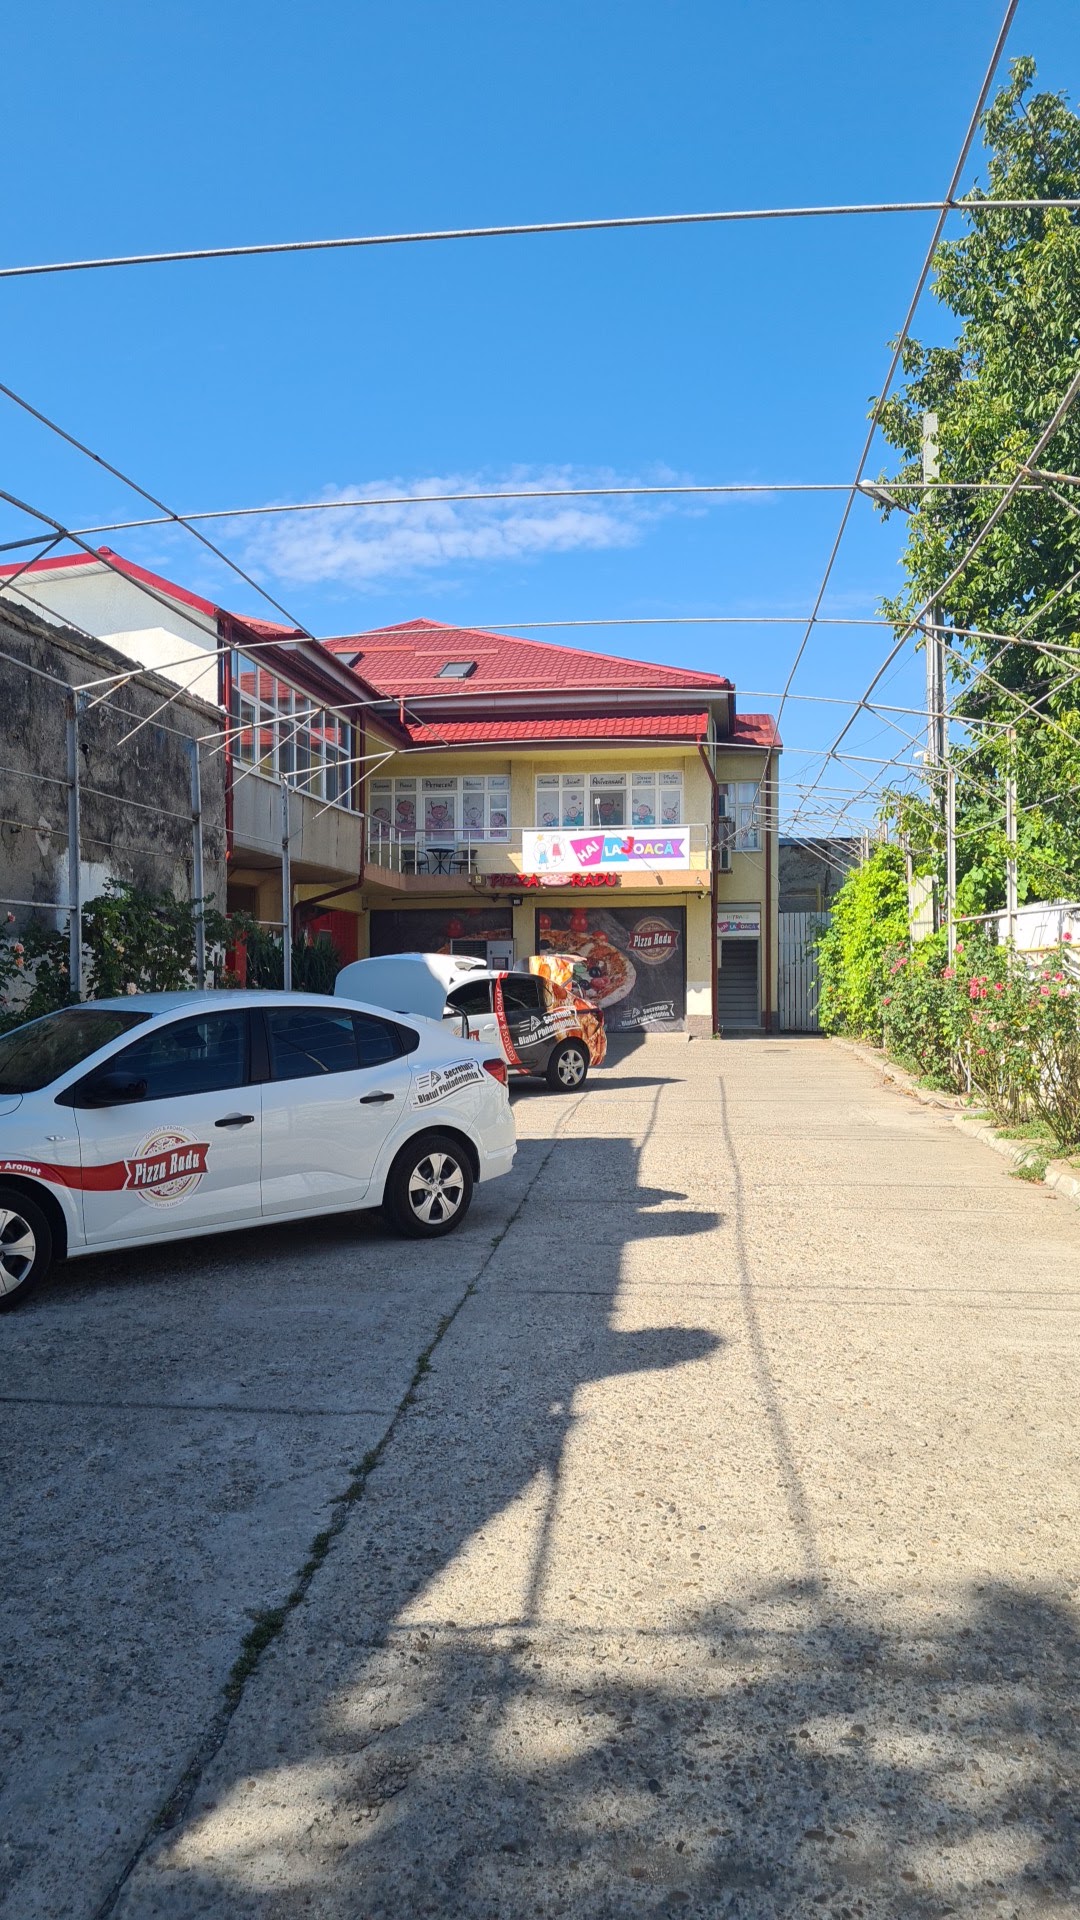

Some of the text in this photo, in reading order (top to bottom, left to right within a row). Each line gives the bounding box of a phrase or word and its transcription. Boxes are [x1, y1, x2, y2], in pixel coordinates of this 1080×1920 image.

[577, 836, 674, 863] HAI LA JOACĂ
[489, 872, 617, 888] PIZZA RADU
[633, 933, 672, 947] Pizza Radu
[439, 1071, 479, 1095] Philadelphia
[5, 1162, 41, 1175] Aromat
[134, 1150, 200, 1185] Pizza Radu
